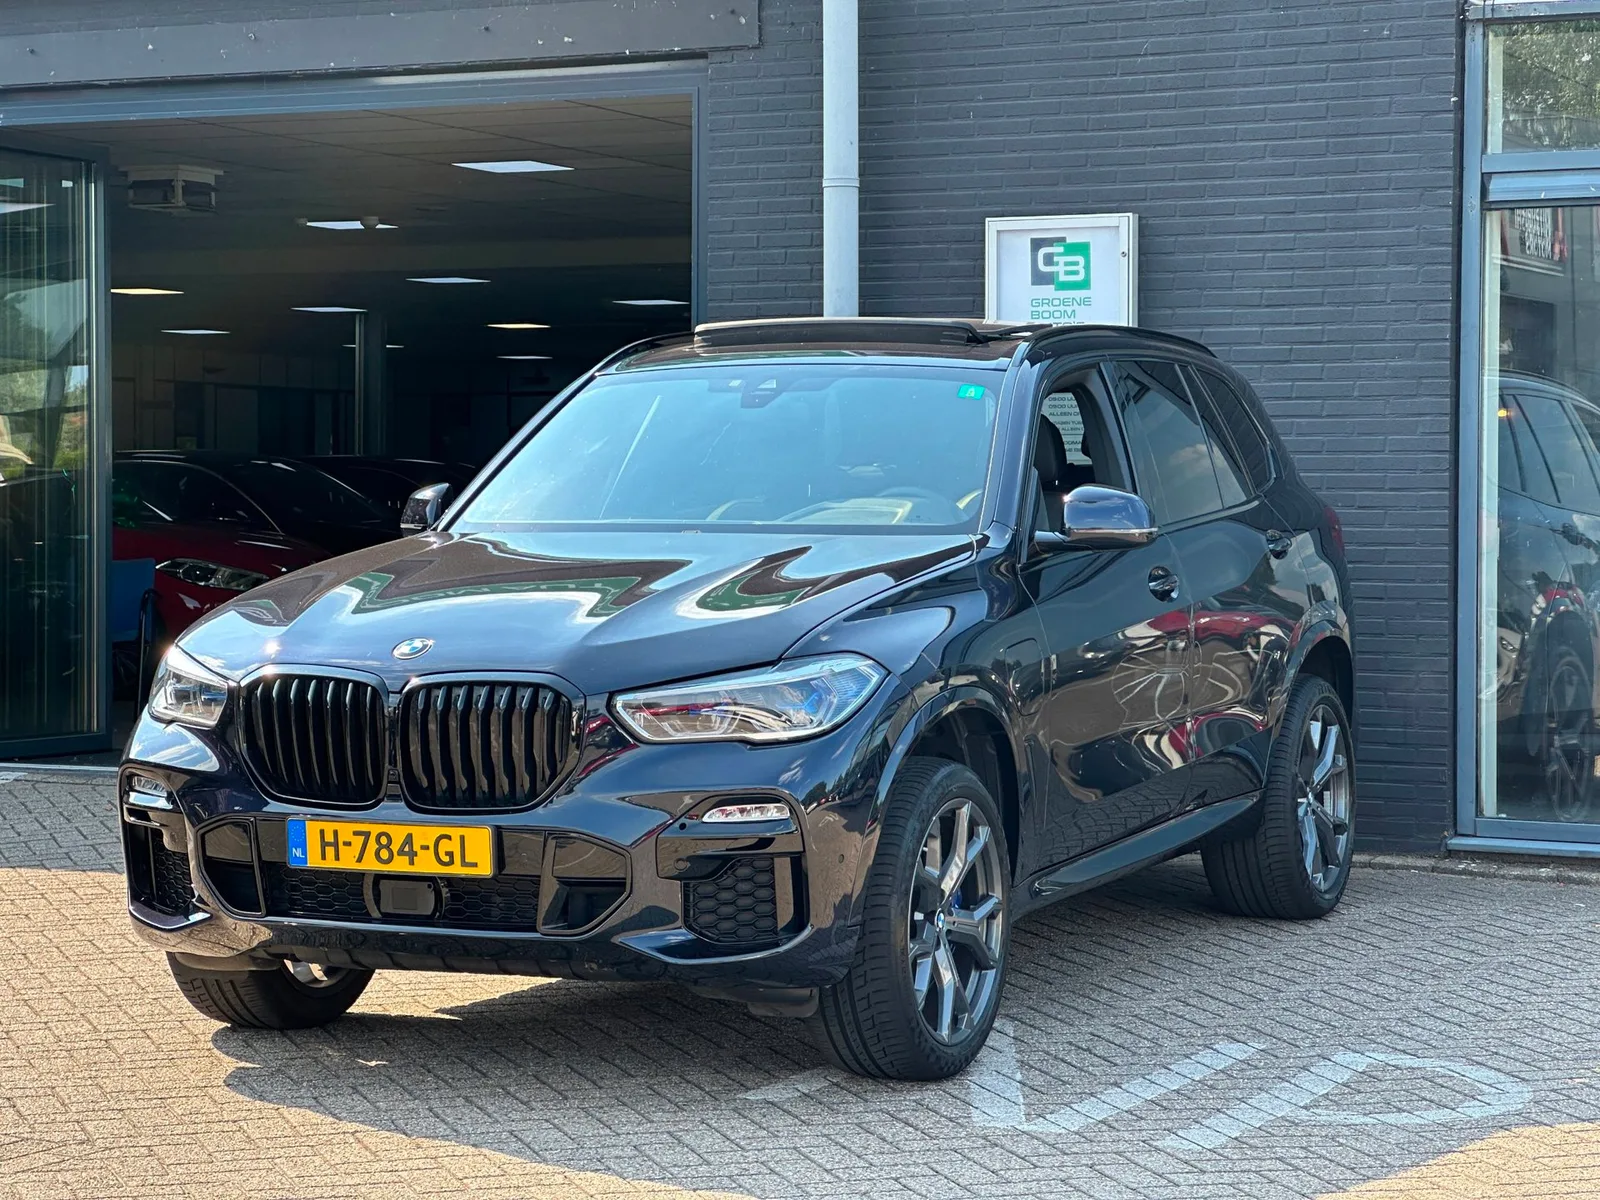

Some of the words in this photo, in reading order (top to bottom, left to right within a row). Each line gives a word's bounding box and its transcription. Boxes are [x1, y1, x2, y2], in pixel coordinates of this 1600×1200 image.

[1030, 296, 1092, 308] GROENE
[1030, 309, 1076, 320] BOOM
[292, 847, 305, 858] NL
[319, 828, 478, 867] H-784-GL
